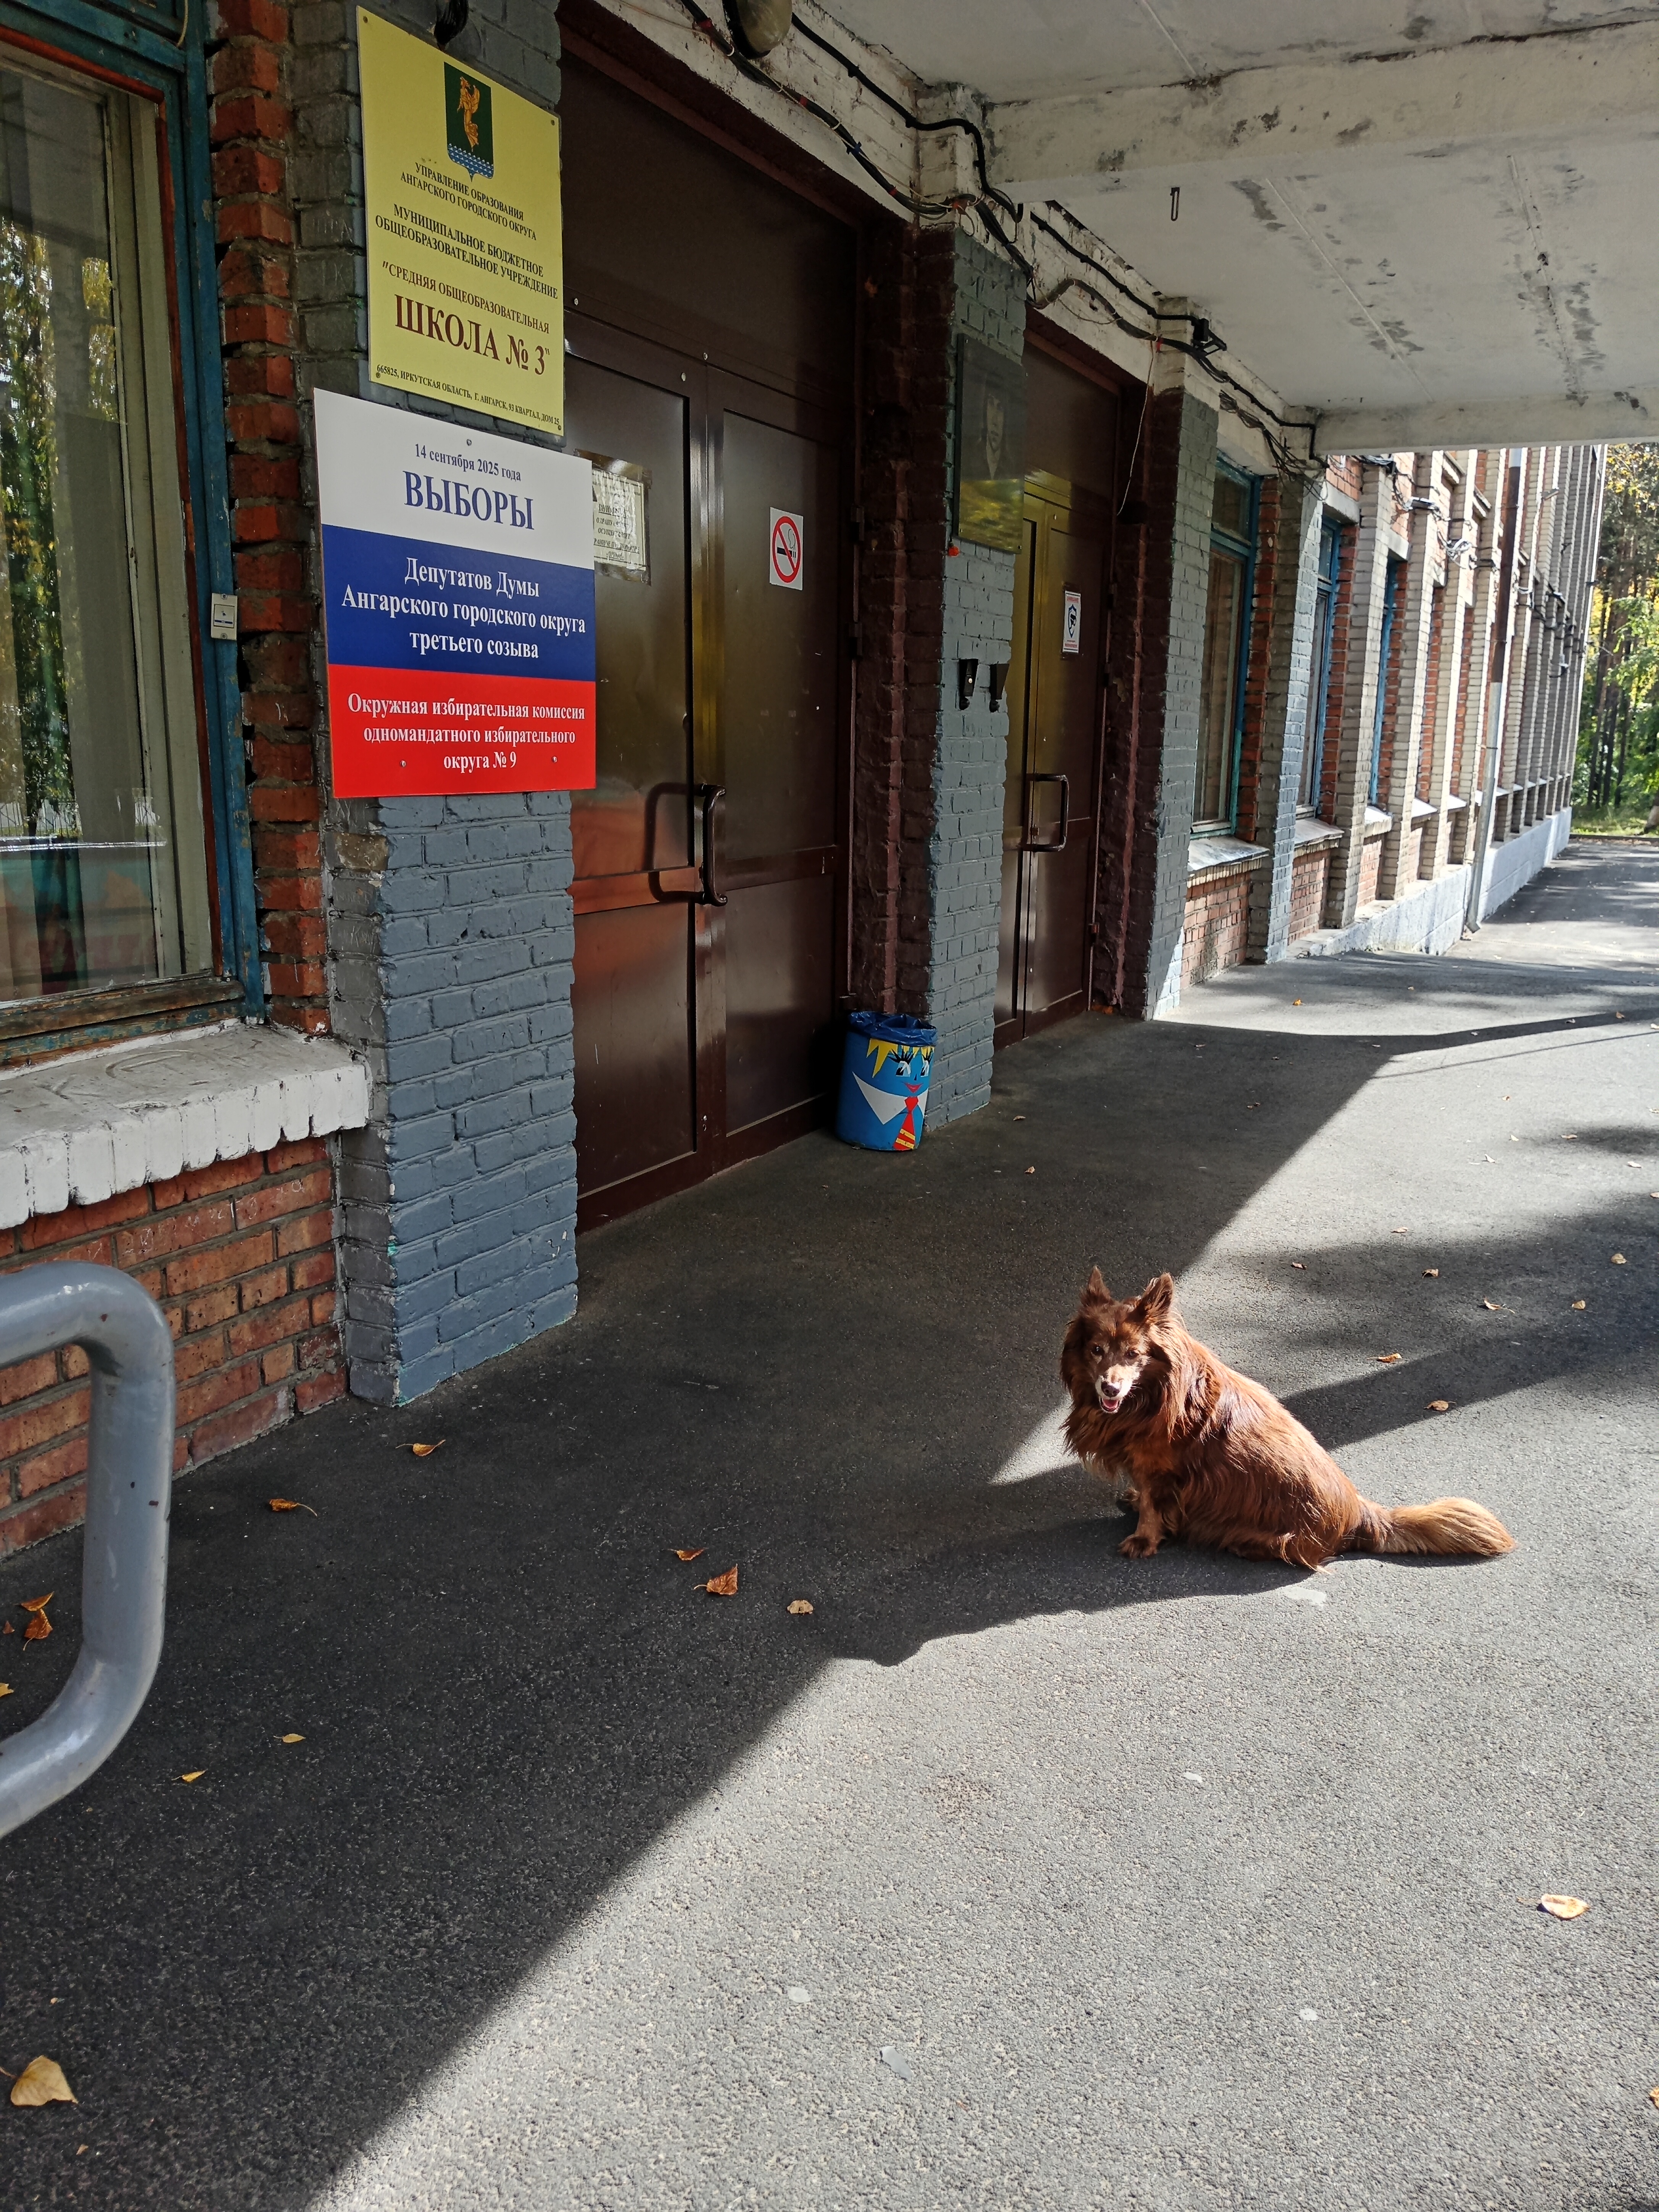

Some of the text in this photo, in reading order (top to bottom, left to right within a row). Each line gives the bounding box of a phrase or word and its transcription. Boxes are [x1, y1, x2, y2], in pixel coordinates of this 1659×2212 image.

[401, 171, 536, 241] АНГАРСКОГО ГОРОДСКОГО ОКРУГА
[415, 162, 523, 221] УПРАВЛЕНИЕ ОБРАЗОВАНИЯ
[375, 215, 558, 299] ОБЩЕОБРАЗОВАТЕЛЬНОЕ УЧРЕЖДЕНИЕ
[394, 204, 543, 277] МУНИЦИПАЛЬНОЕ БЮДЖЕТНОЕ
[394, 294, 500, 361] ШКОЛА
[506, 334, 529, 370] №
[438, 282, 549, 334] ОБЩЕОБРАЗОВАТЕЛЬНАЯ
[377, 364, 559, 425] 665825, ИРКУТСКАЯ ОБЛАСТЬ, Г. АНГАРСК, 93 КВАРТАЛ, ДОМ 25
[415, 443, 521, 482] 14 сентября 2025 года
[402, 471, 535, 530] ВЫБОРЫ
[404, 557, 539, 599] Депутатов Думы
[341, 584, 586, 637] Ангарского городского округа
[409, 632, 539, 658] третьего созыва
[348, 693, 585, 721] Окружная избирательная комиссия
[364, 726, 575, 747] одномандатного избирательного
[443, 751, 516, 773] округа № 9
